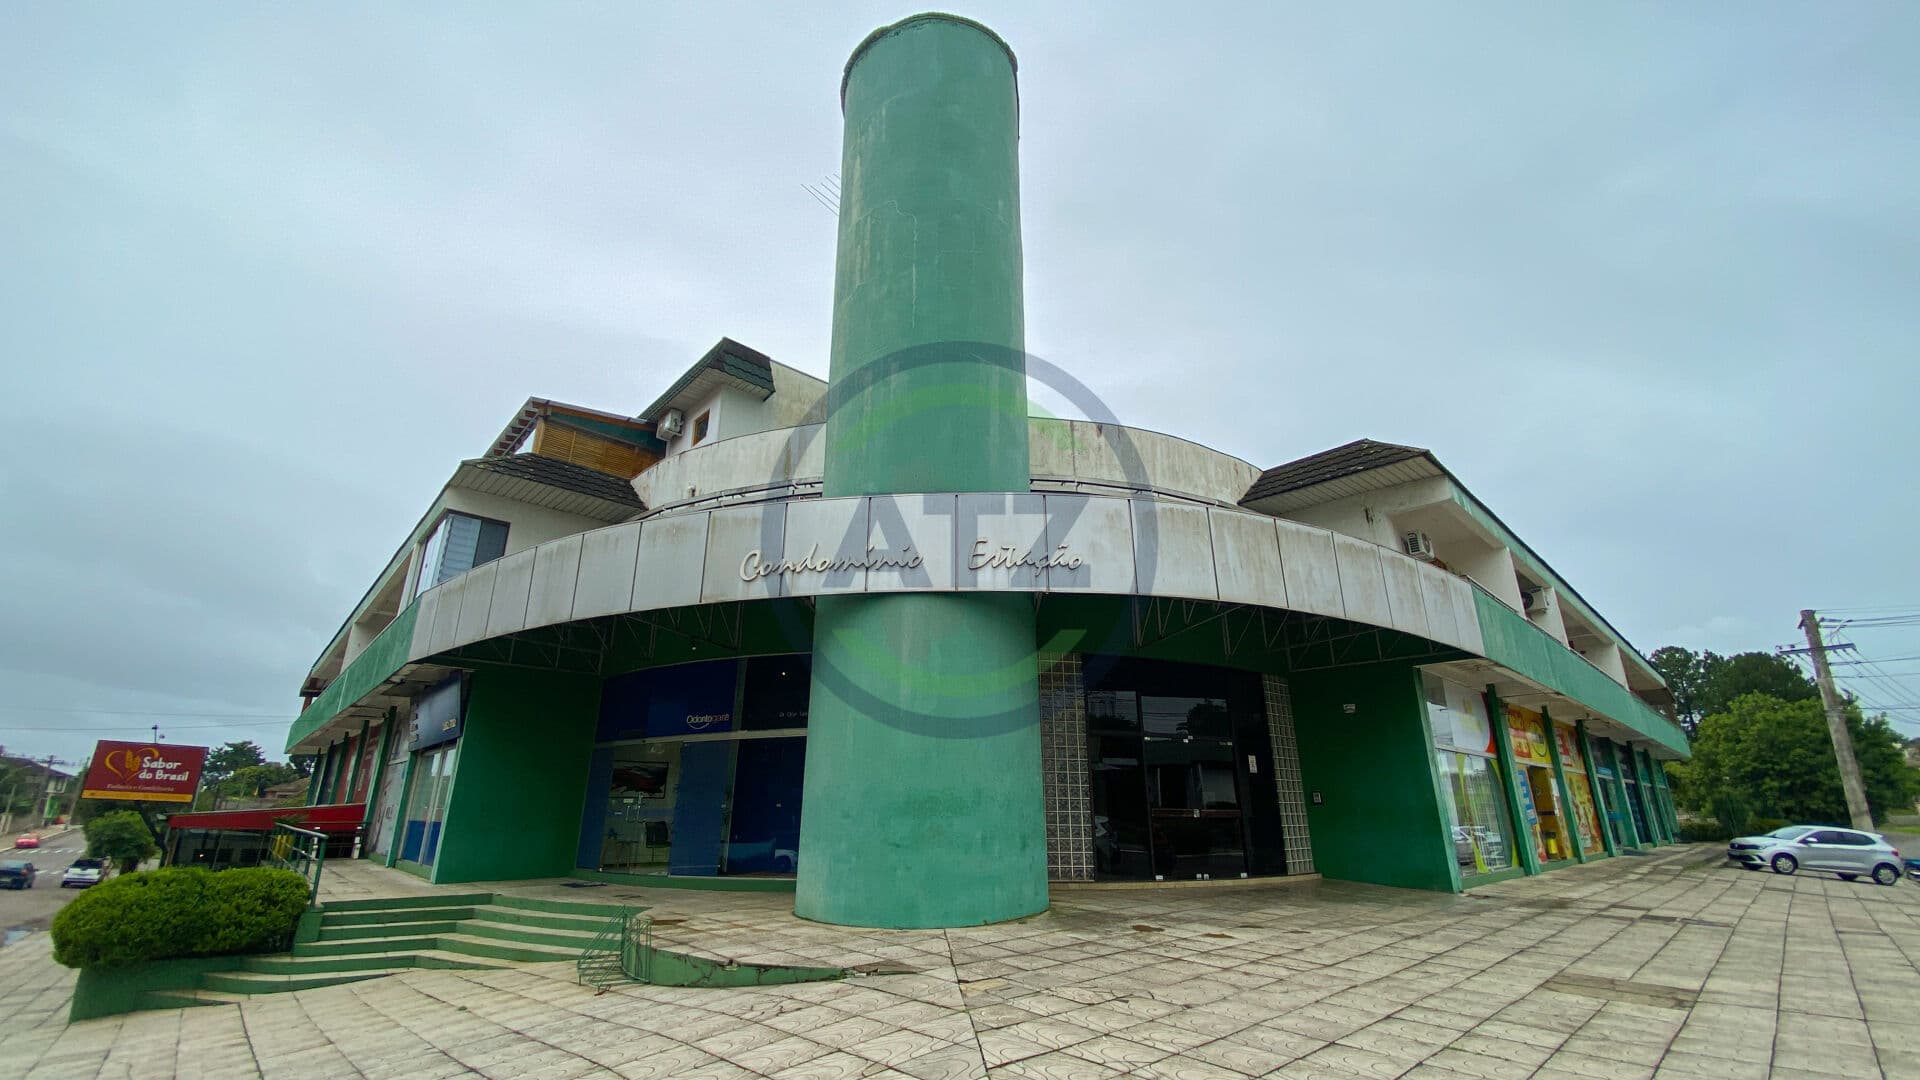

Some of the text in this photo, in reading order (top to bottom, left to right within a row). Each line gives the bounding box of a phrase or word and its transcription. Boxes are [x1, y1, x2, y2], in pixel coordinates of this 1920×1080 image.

[739, 536, 1084, 582] Condomínio Estação
[142, 756, 182, 769] Sabor
[138, 769, 189, 781] do Brasil
